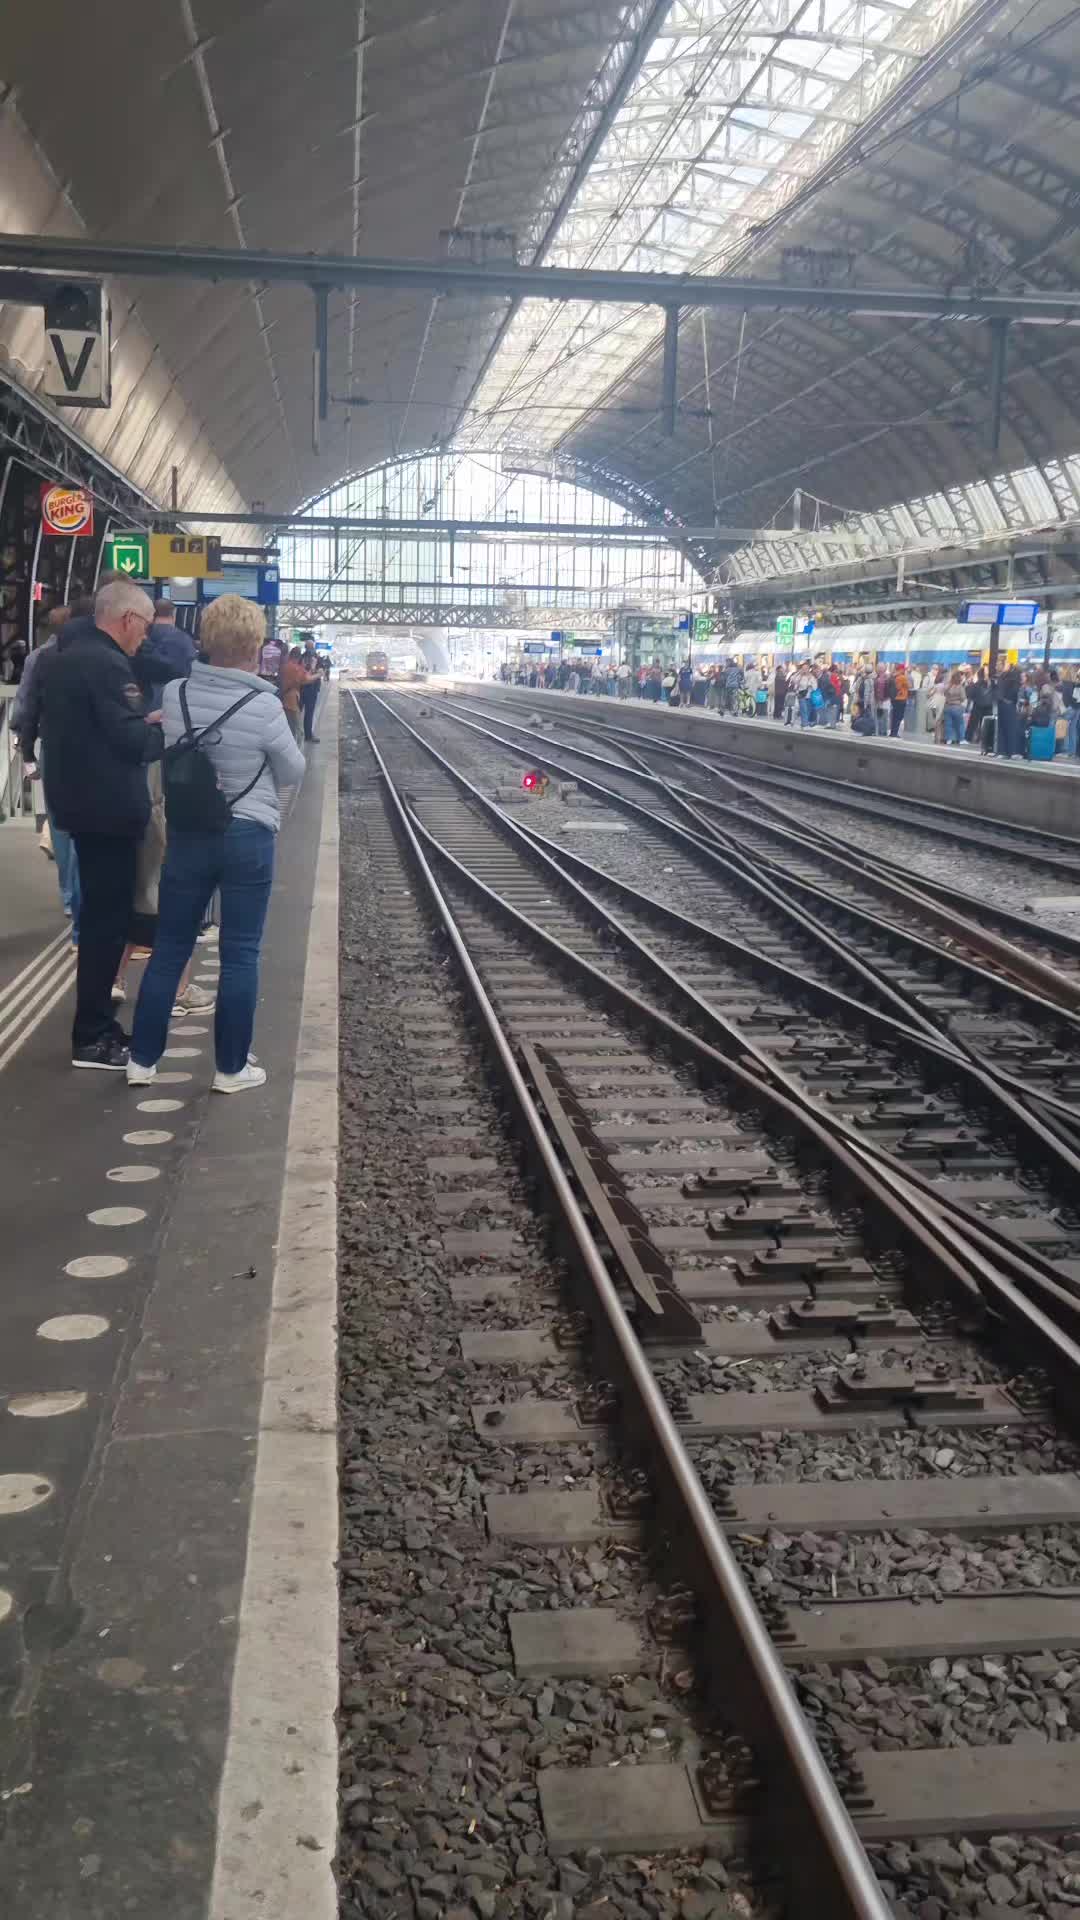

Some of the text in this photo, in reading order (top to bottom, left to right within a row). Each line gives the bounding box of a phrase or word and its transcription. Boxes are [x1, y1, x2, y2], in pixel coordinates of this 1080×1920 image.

[50, 333, 96, 392] V
[48, 493, 86, 510] BURGER
[50, 503, 85, 520] KING
